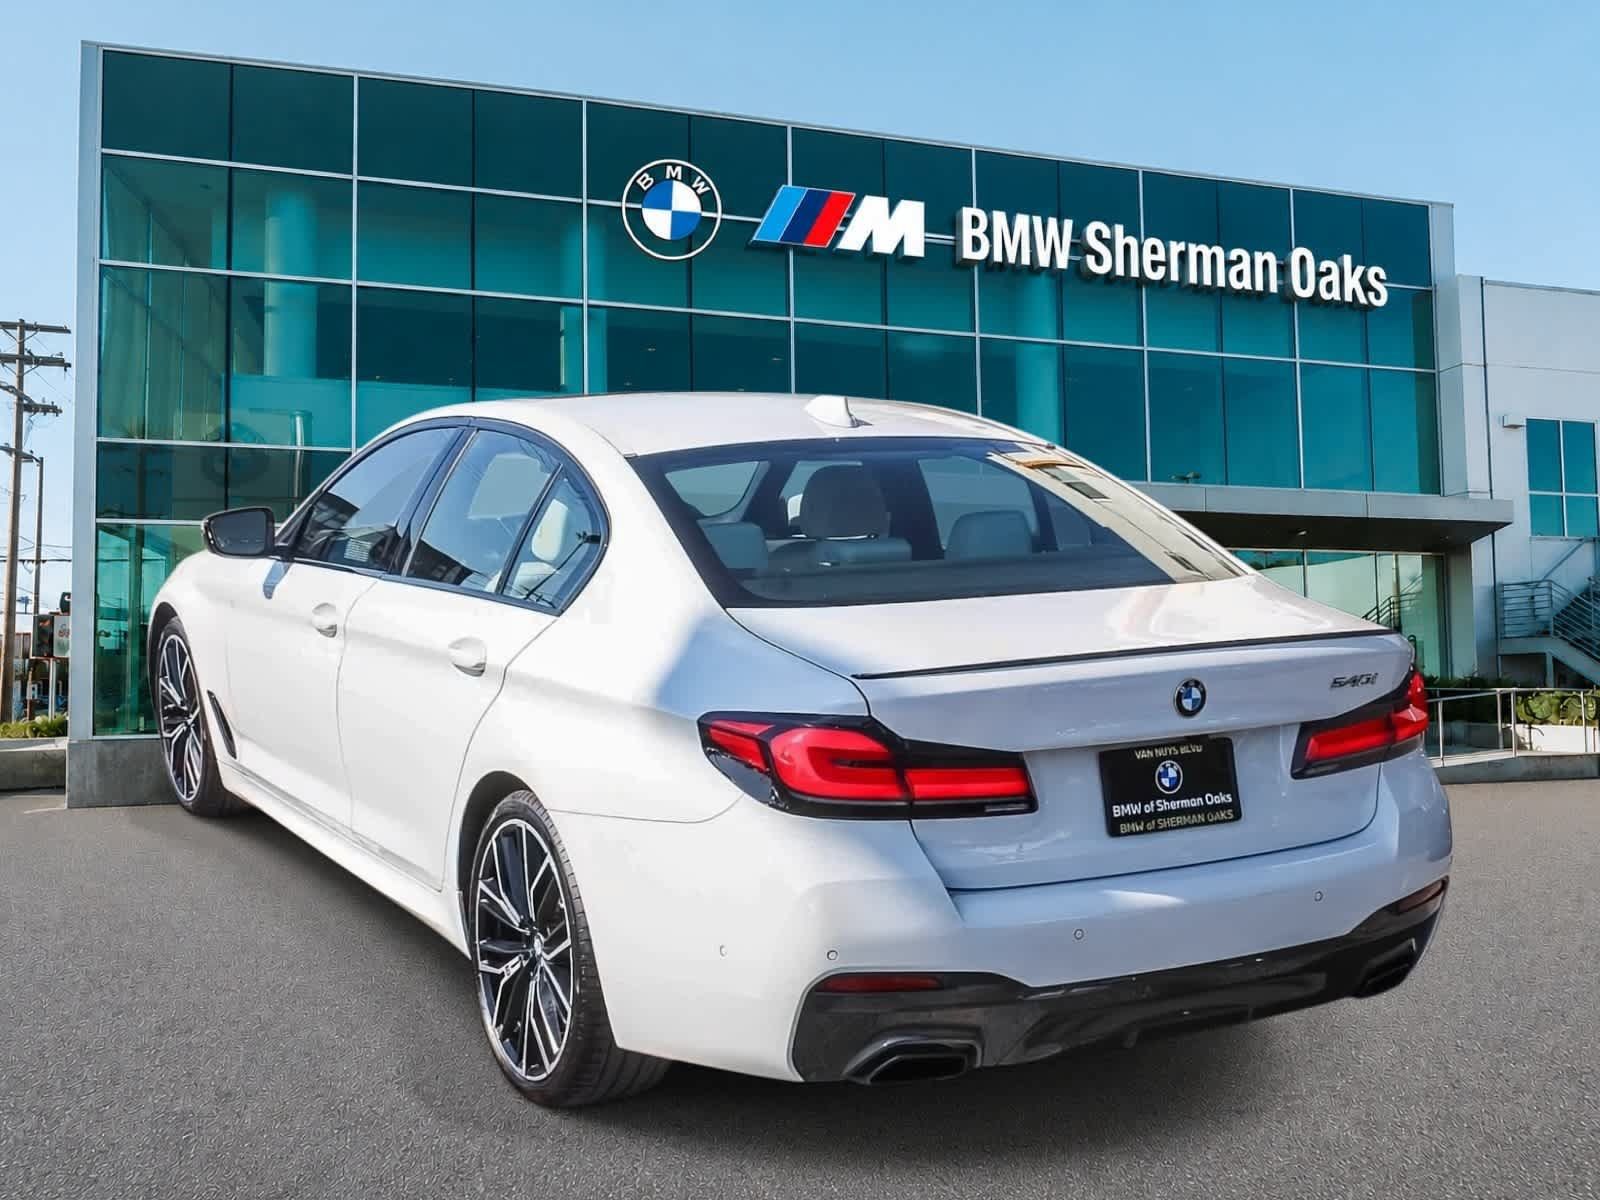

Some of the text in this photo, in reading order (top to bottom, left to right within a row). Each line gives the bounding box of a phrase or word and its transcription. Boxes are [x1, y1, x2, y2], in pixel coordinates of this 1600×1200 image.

[636, 165, 711, 195] BMW
[835, 194, 926, 258] M
[959, 206, 1389, 308] BMW Sherman Oaks
[1135, 748, 1153, 760] VAN
[1154, 746, 1179, 757] NUYS
[1112, 791, 1233, 818] BMW of Sherman Oaks
[1120, 809, 1235, 834] BMW of SHERMAN OAKS
